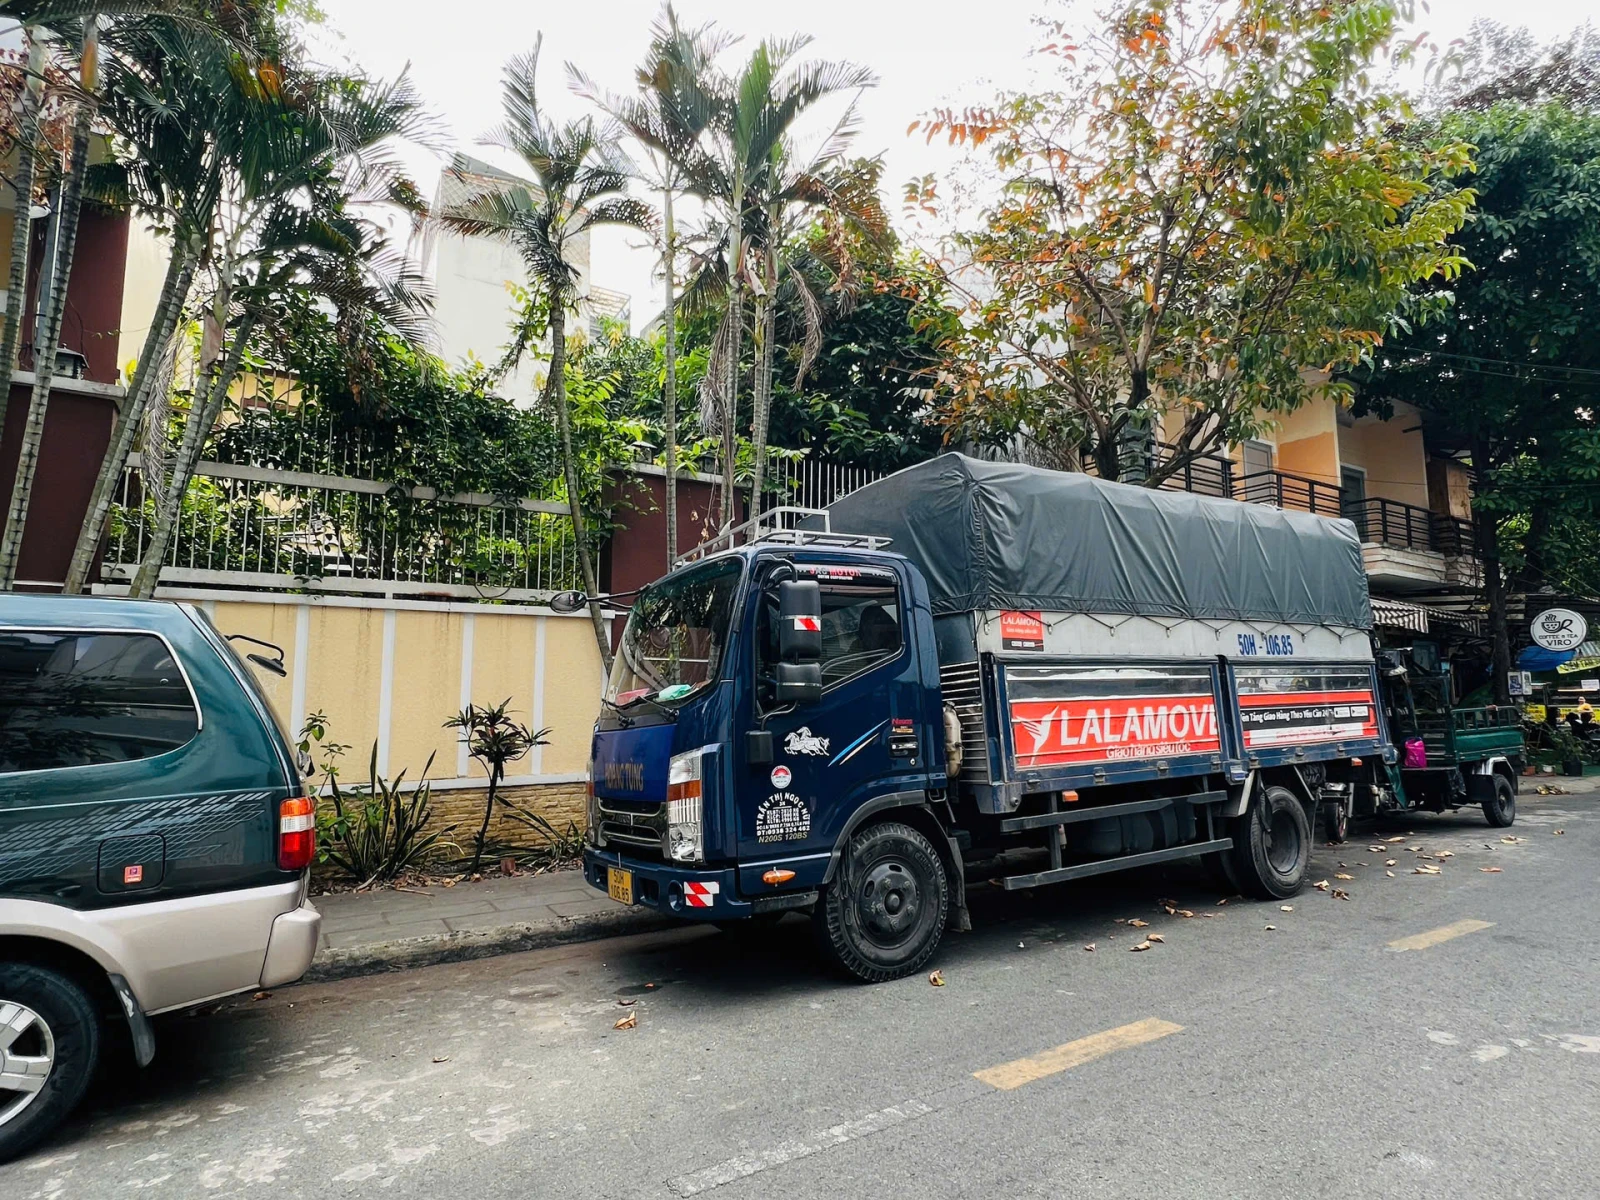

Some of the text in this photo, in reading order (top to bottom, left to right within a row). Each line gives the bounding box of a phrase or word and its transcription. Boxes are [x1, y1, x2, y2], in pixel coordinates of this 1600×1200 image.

[829, 568, 862, 576] MOTOR
[1003, 616, 1040, 626] LALAMOVE
[1237, 634, 1257, 655] 50H
[1264, 634, 1293, 655] 106.85
[758, 832, 808, 843] N200S 120BS
